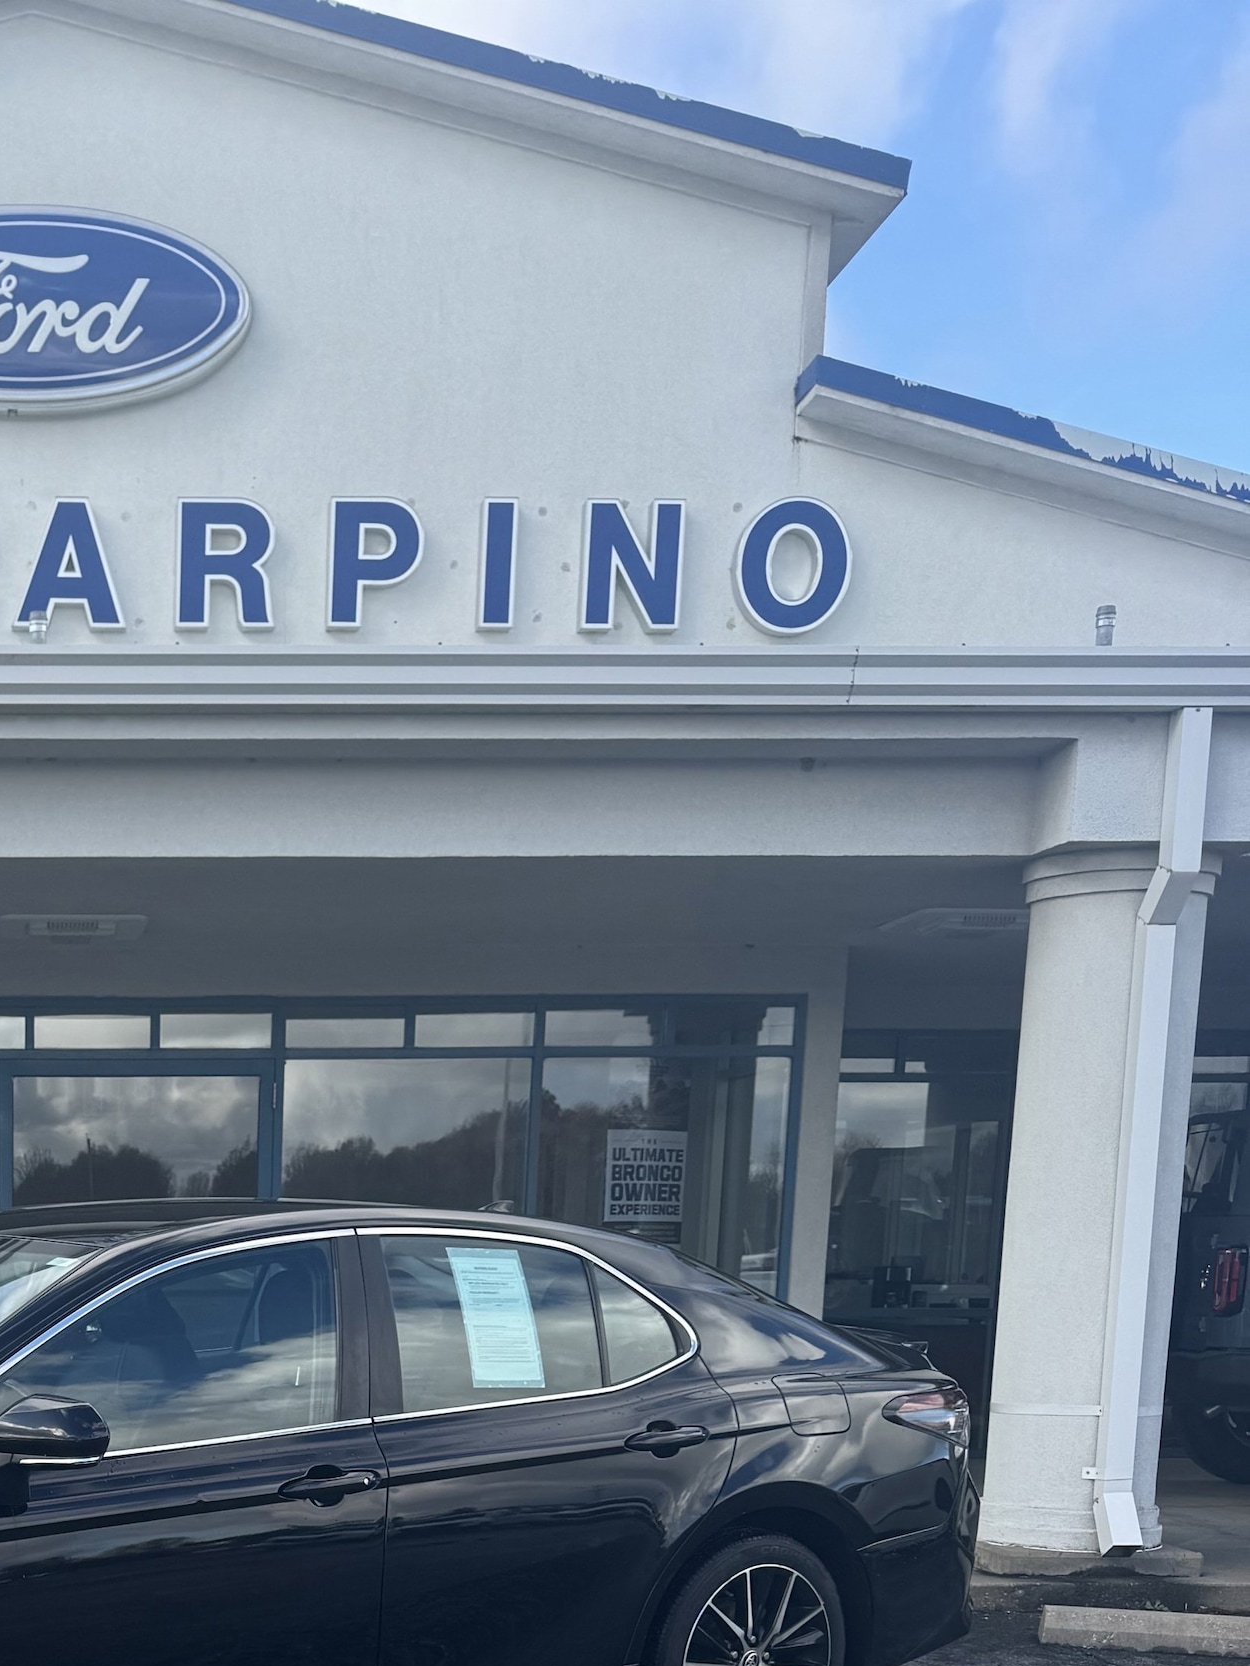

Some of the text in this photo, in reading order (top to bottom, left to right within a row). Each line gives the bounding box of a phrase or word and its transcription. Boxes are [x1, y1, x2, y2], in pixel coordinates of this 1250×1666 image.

[640, 1137, 658, 1146] THE
[612, 1147, 684, 1163] ULTIMATE
[611, 1164, 683, 1182] BRONCO
[610, 1183, 681, 1202] OWNER
[609, 1203, 681, 1216] EXPERIENCE
